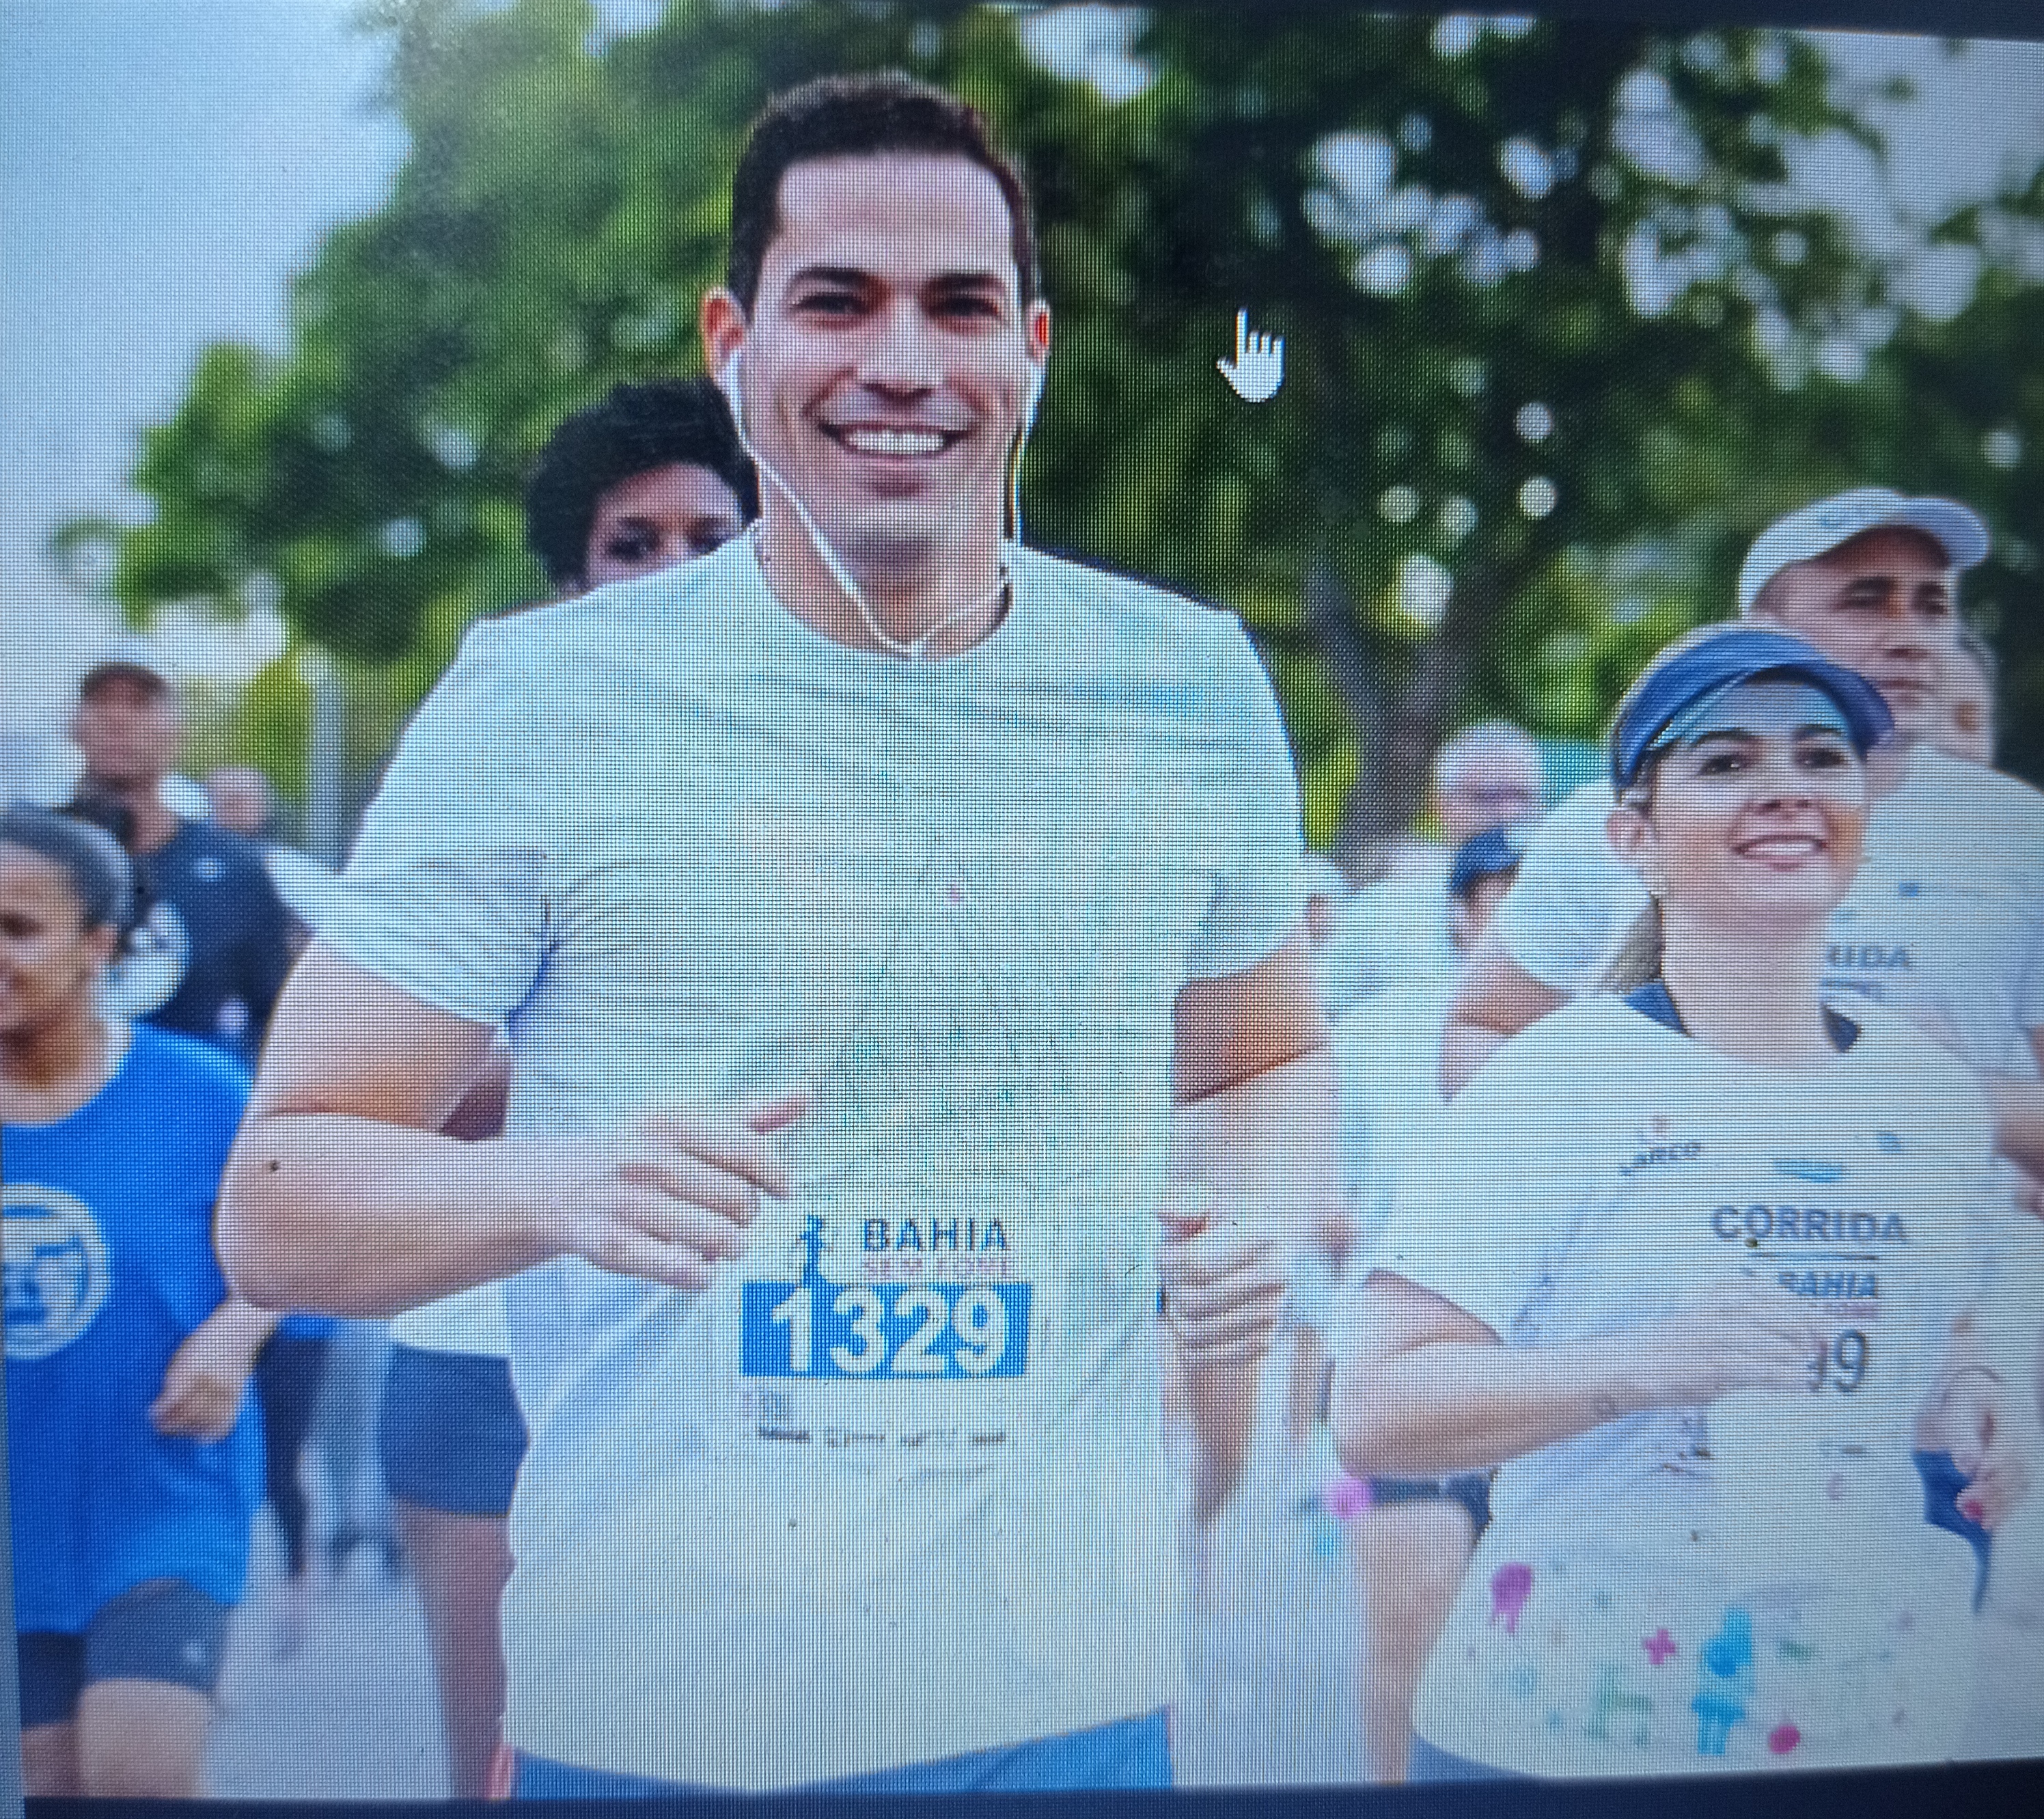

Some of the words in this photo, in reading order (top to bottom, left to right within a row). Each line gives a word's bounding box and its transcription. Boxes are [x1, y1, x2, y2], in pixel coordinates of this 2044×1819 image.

[862, 1218, 1009, 1251] BAHIA
[1712, 1205, 1907, 1244] CORRIDA
[771, 1287, 1010, 1373] 1329
